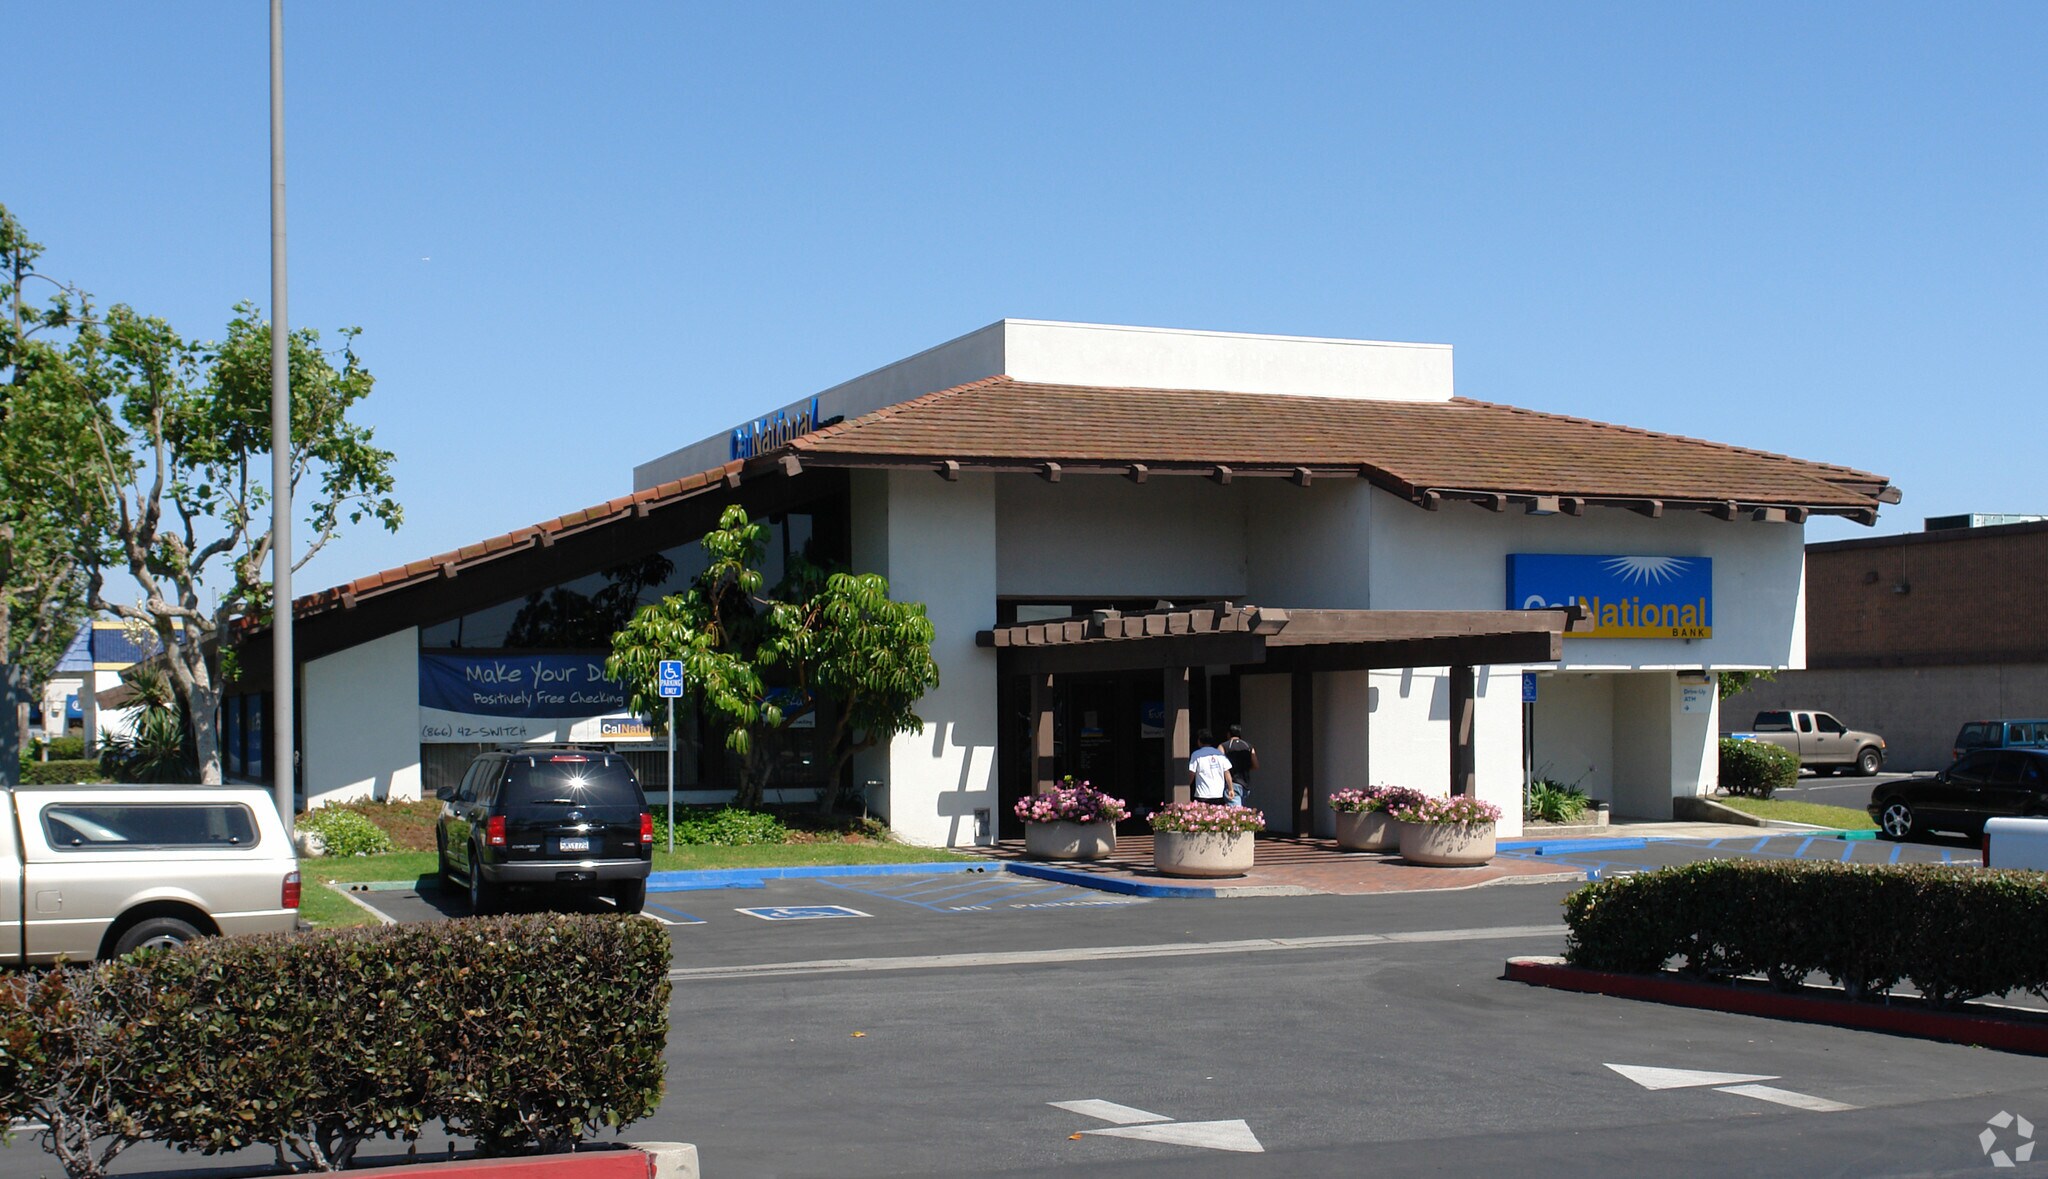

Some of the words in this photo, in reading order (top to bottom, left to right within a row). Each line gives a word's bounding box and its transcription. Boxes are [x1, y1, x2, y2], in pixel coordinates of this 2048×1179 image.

[1523, 595, 1706, 627] CNational
[1672, 628, 1705, 637] BANK
[466, 661, 521, 684] Make
[531, 661, 577, 689] Your
[660, 679, 681, 687] PARKING
[664, 687, 678, 695] ONLY
[473, 692, 532, 709] Positively
[537, 692, 565, 705] Free
[570, 691, 624, 708] Checking
[422, 725, 452, 738] (866)
[457, 725, 527, 738] 42-SWITCH
[602, 723, 654, 735] CalNatio
